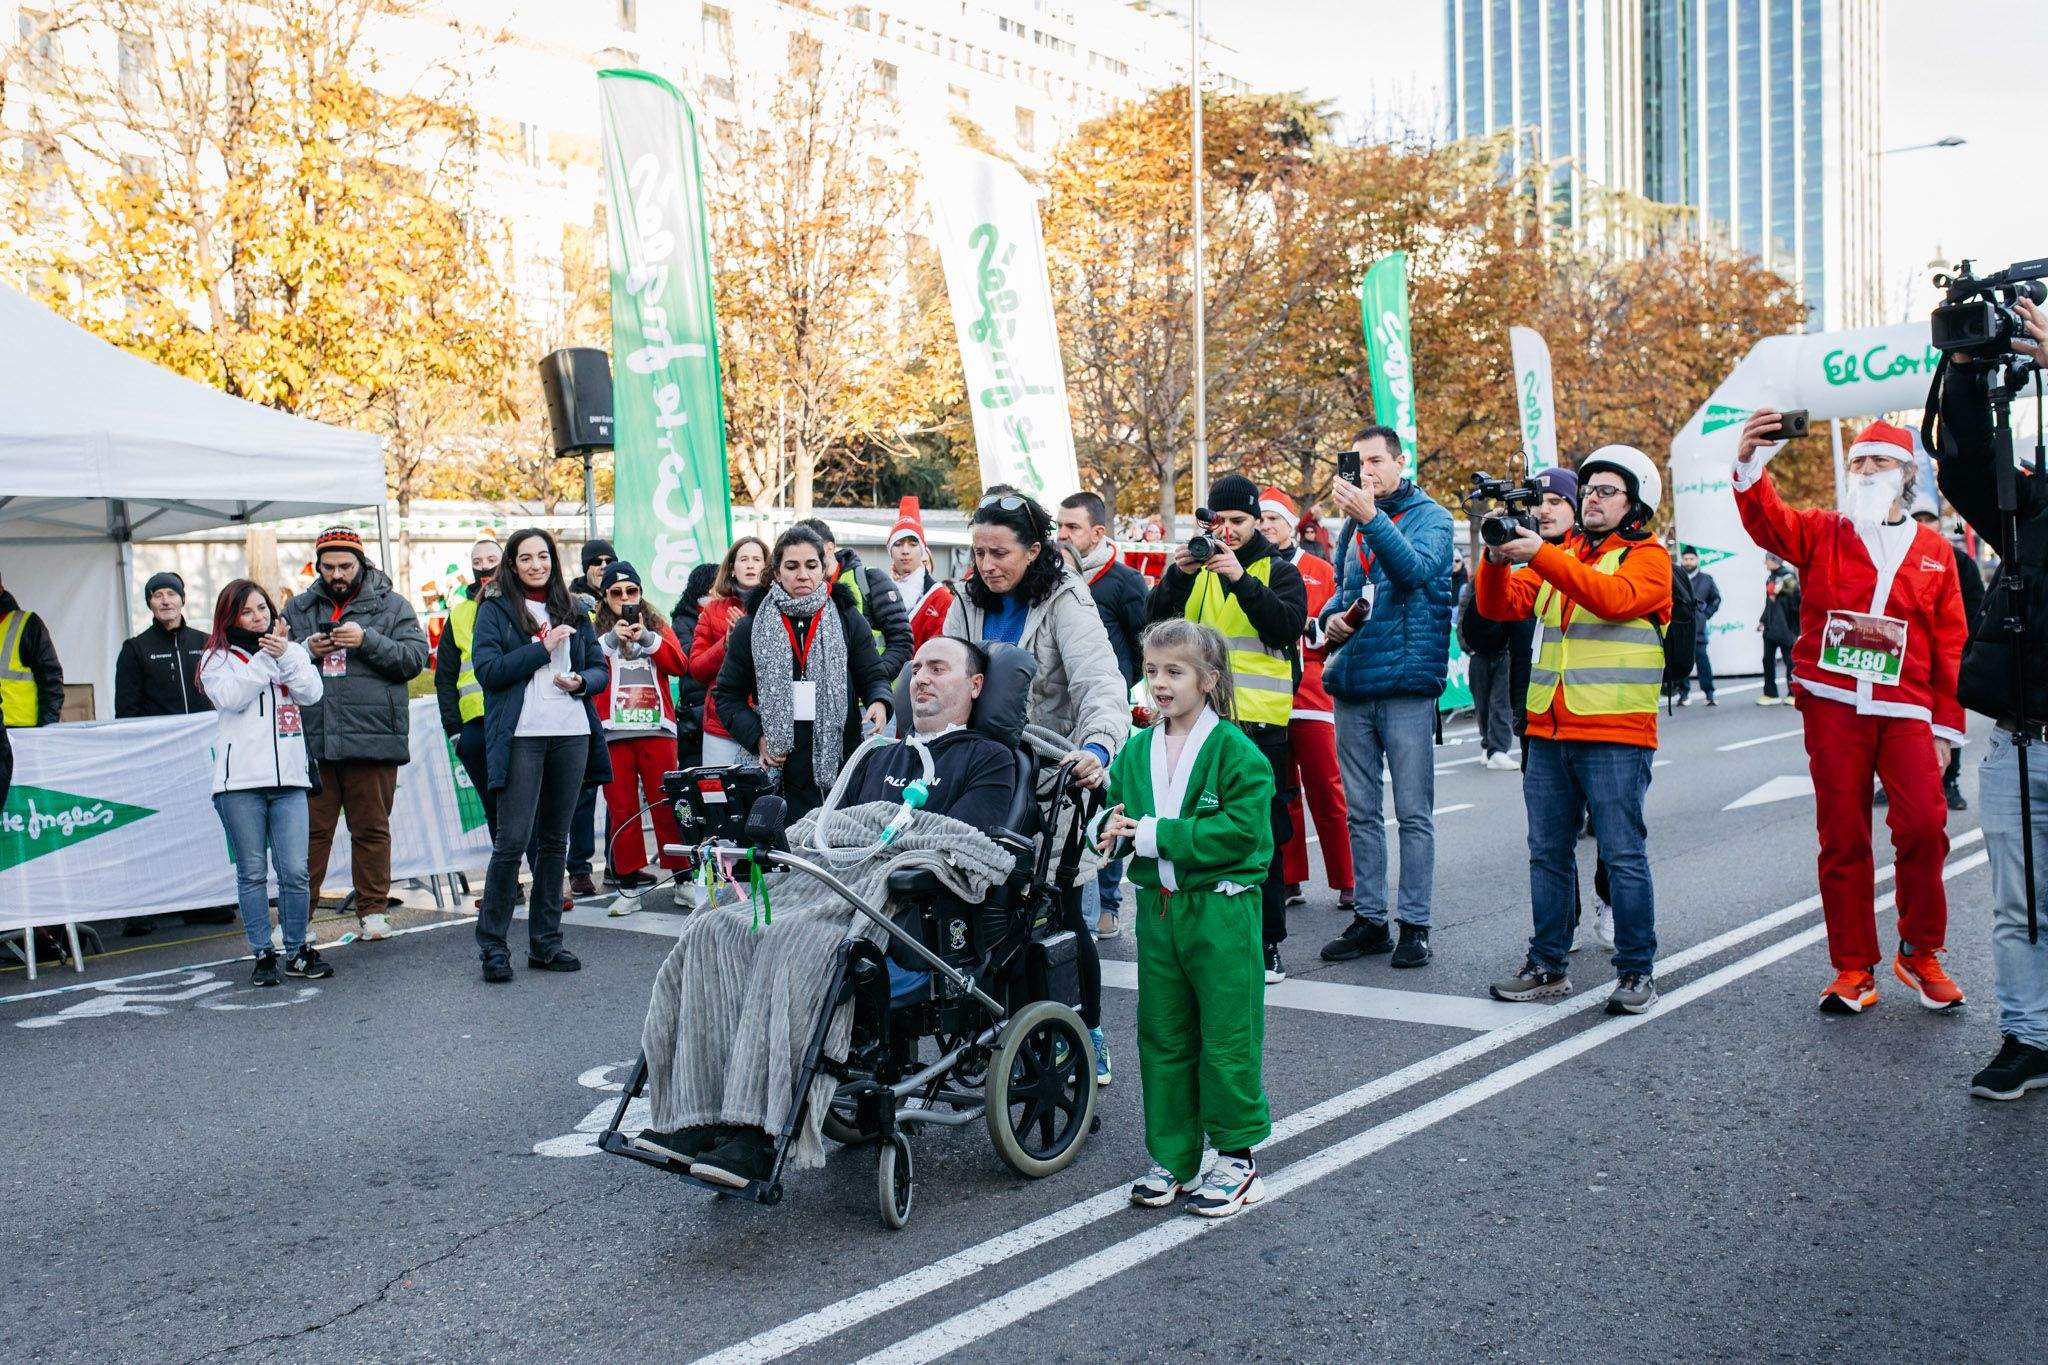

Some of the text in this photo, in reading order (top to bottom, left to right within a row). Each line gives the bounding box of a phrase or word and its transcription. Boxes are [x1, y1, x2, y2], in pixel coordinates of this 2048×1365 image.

[1823, 345, 1942, 386] El Cort
[1836, 646, 1887, 672] 5480
[622, 709, 654, 722] 5453
[28, 798, 114, 840] Inglés
